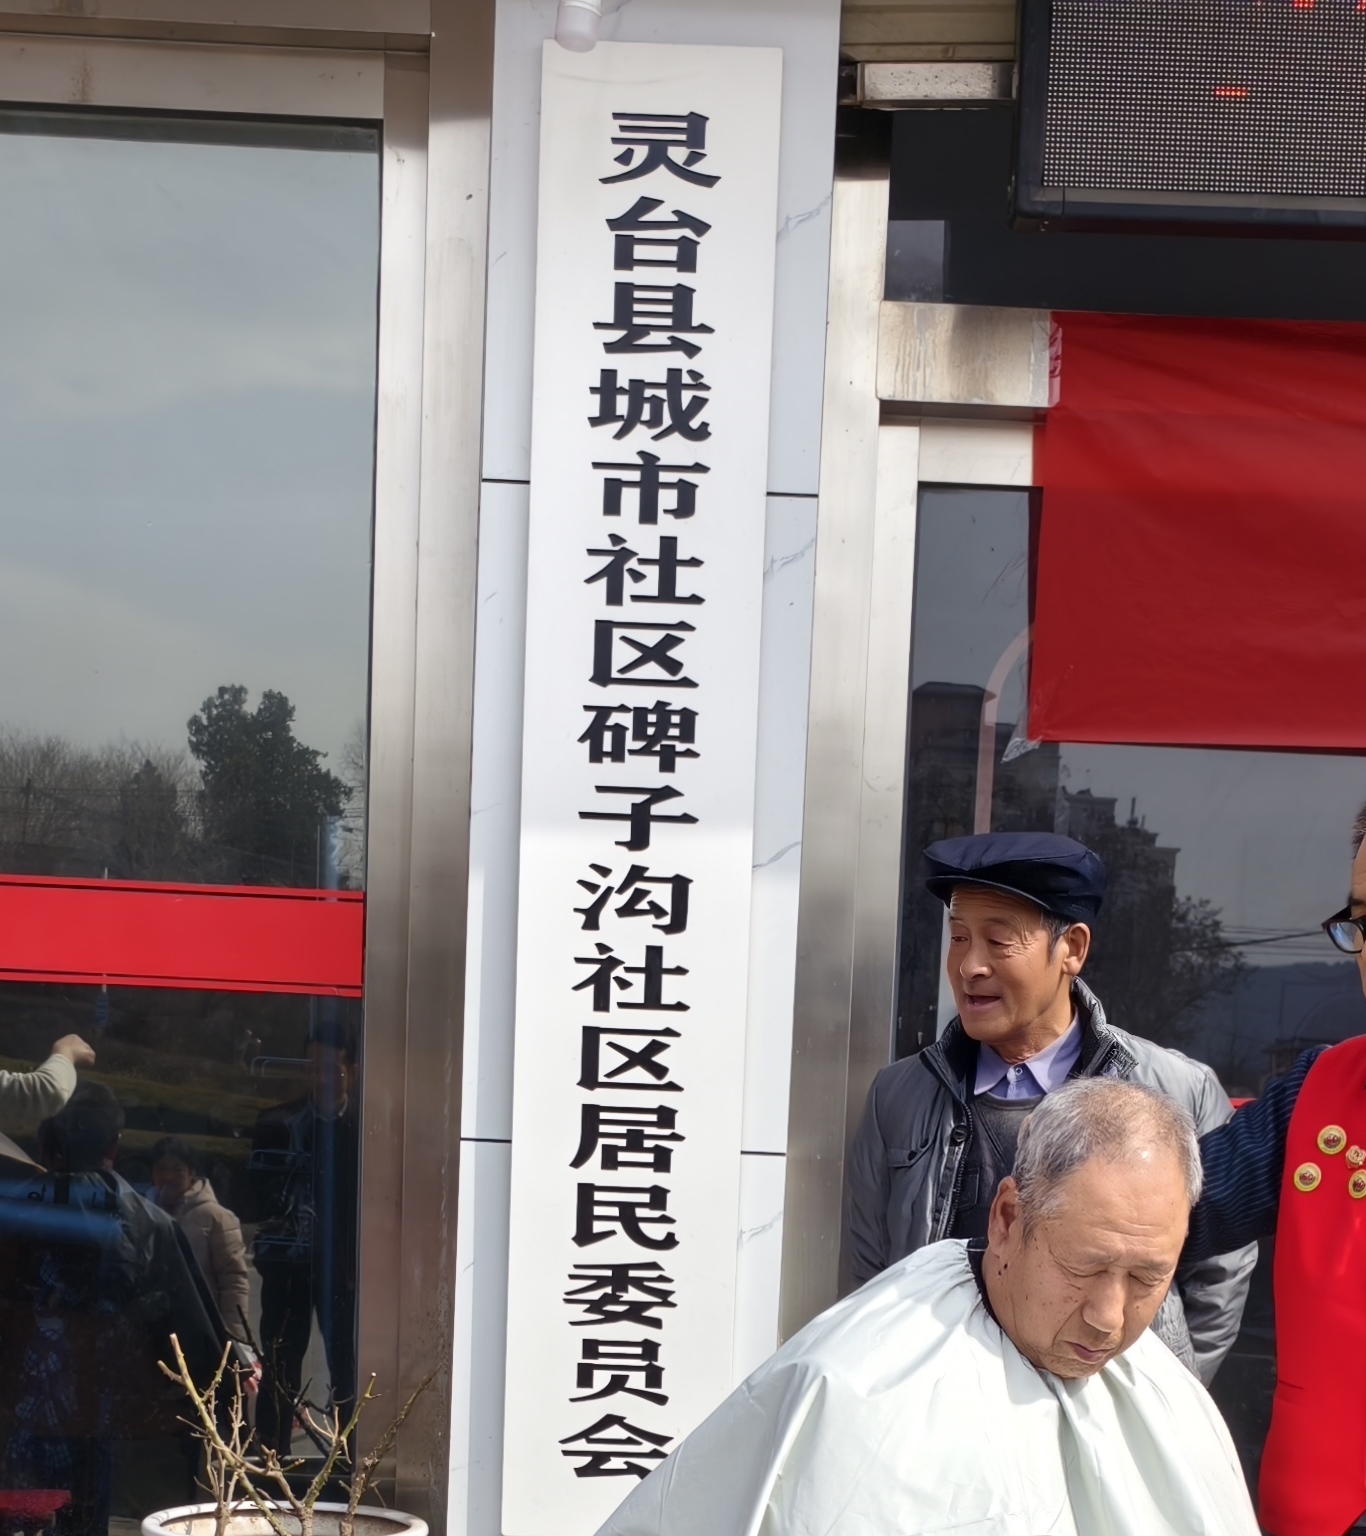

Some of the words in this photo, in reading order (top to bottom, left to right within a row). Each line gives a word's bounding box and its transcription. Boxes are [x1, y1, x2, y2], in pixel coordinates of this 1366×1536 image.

[558, 111, 721, 1480] 灵台县城市社区碑子沟社区居民委员会
